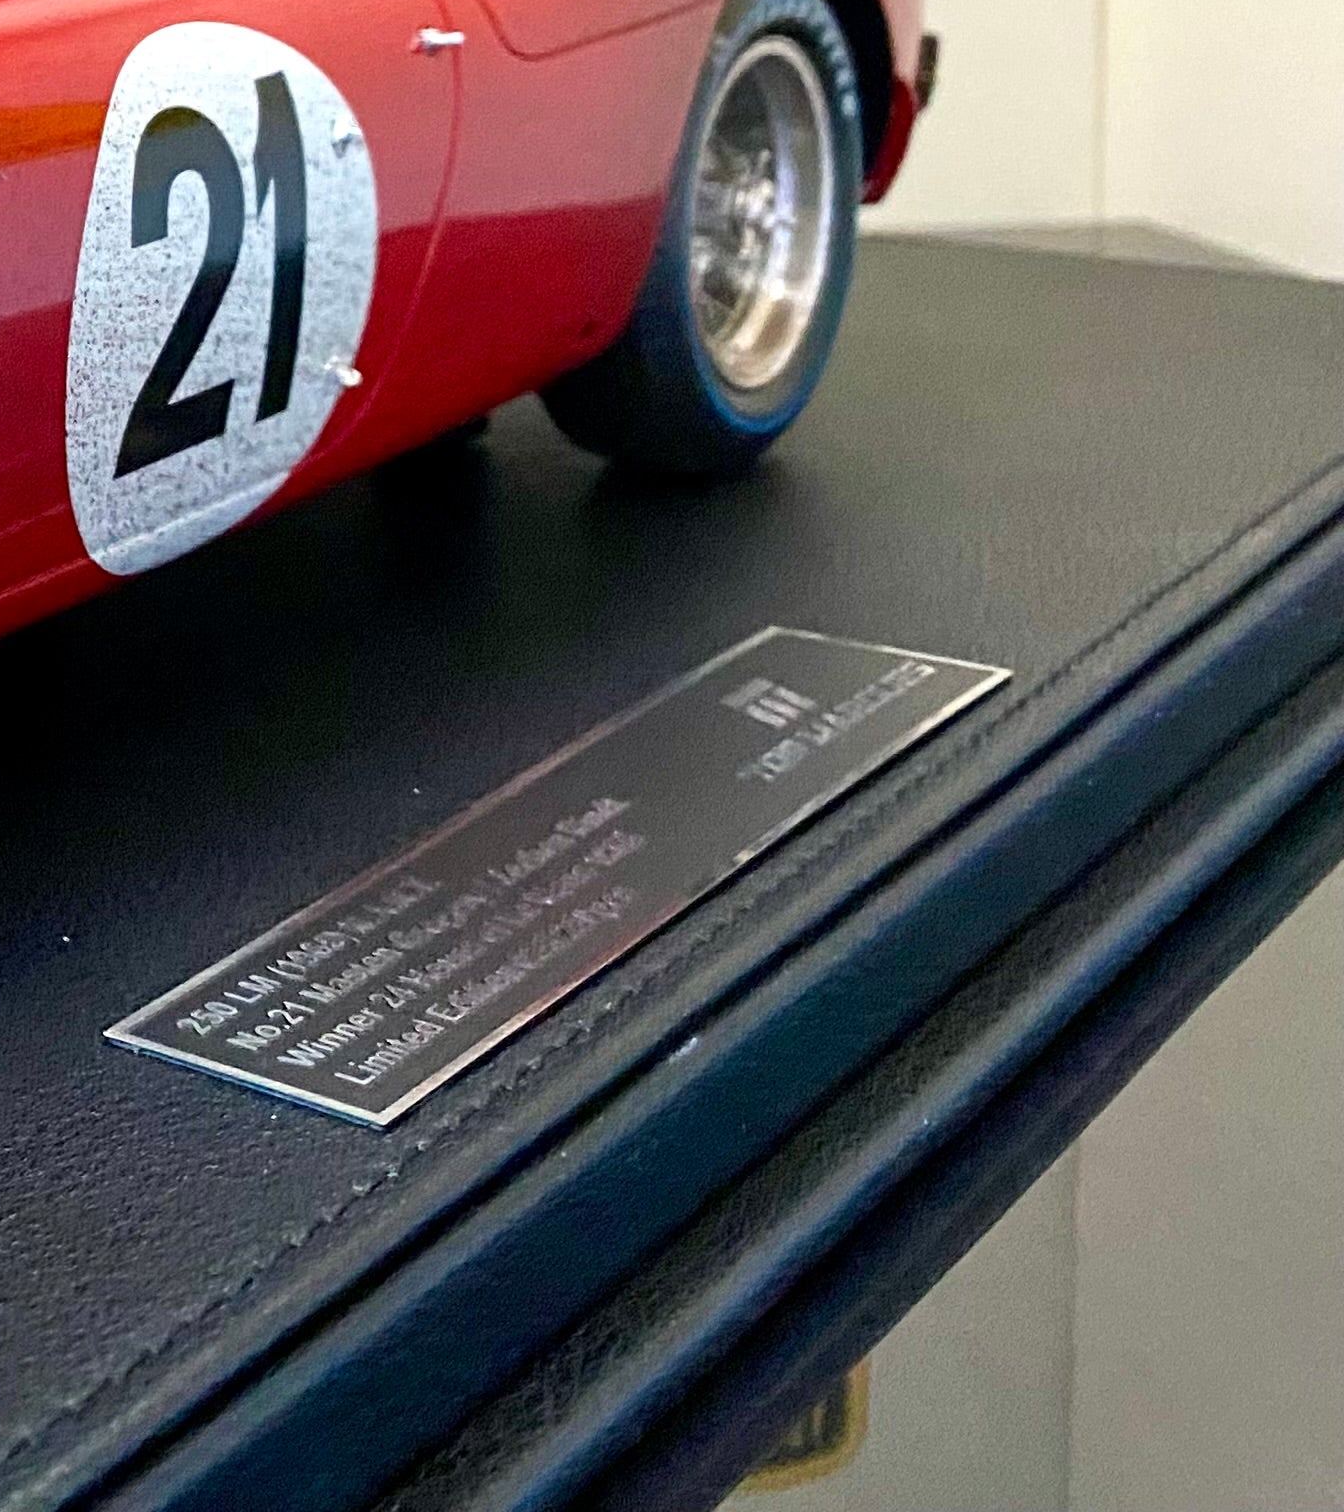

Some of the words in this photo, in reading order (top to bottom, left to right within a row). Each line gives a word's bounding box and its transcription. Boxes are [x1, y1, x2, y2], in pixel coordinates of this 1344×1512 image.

[114, 71, 307, 479] 21
[176, 1001, 239, 1037] 250
[223, 974, 282, 1003] LM
[226, 1001, 315, 1051] No.21
[276, 1007, 384, 1067] Winner
[368, 984, 418, 1009] 24
[333, 1018, 445, 1085] Limited
